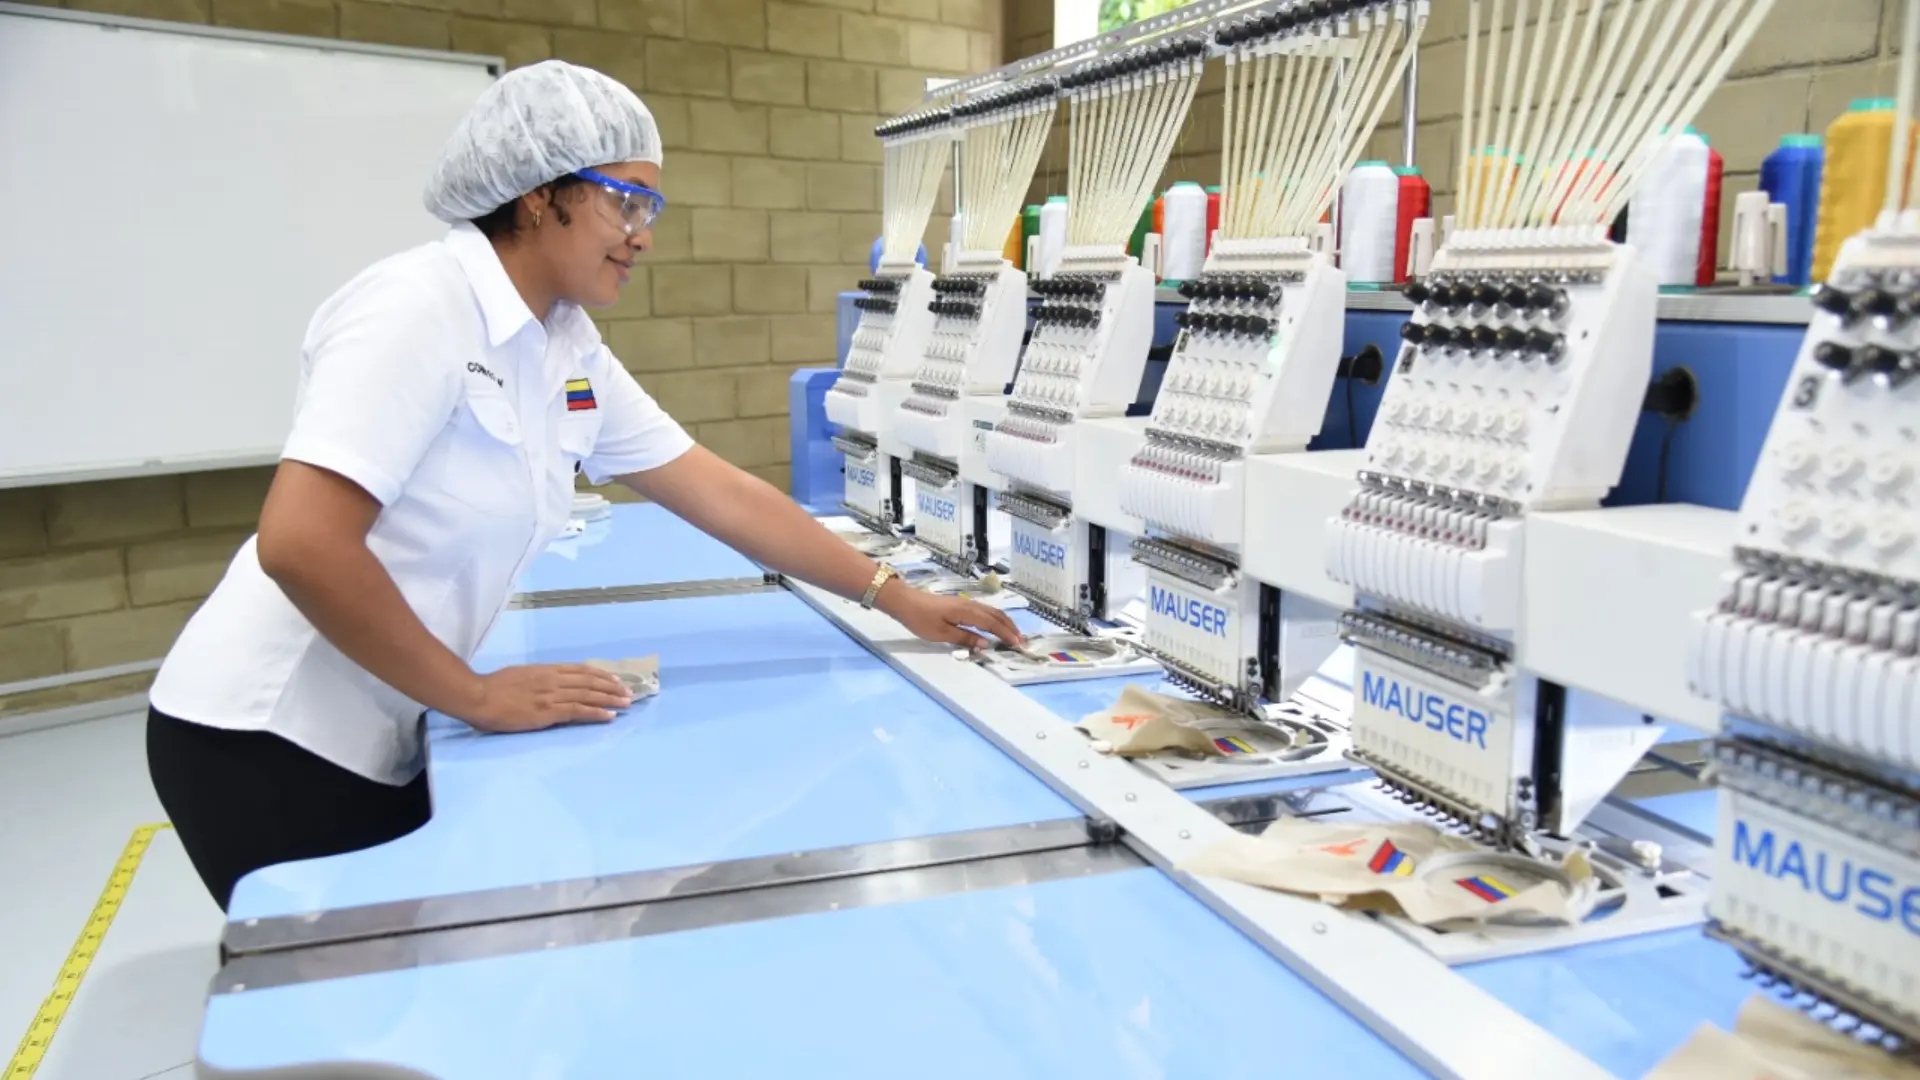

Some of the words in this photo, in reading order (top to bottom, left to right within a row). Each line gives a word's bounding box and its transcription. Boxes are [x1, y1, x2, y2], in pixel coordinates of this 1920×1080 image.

[1795, 376, 1819, 408] 3
[847, 465, 876, 489] MAUSER
[918, 492, 956, 522] MAUSER
[1014, 531, 1065, 570] MAUSER
[1151, 586, 1226, 638] MAUSER
[1363, 671, 1487, 750] MAUSER
